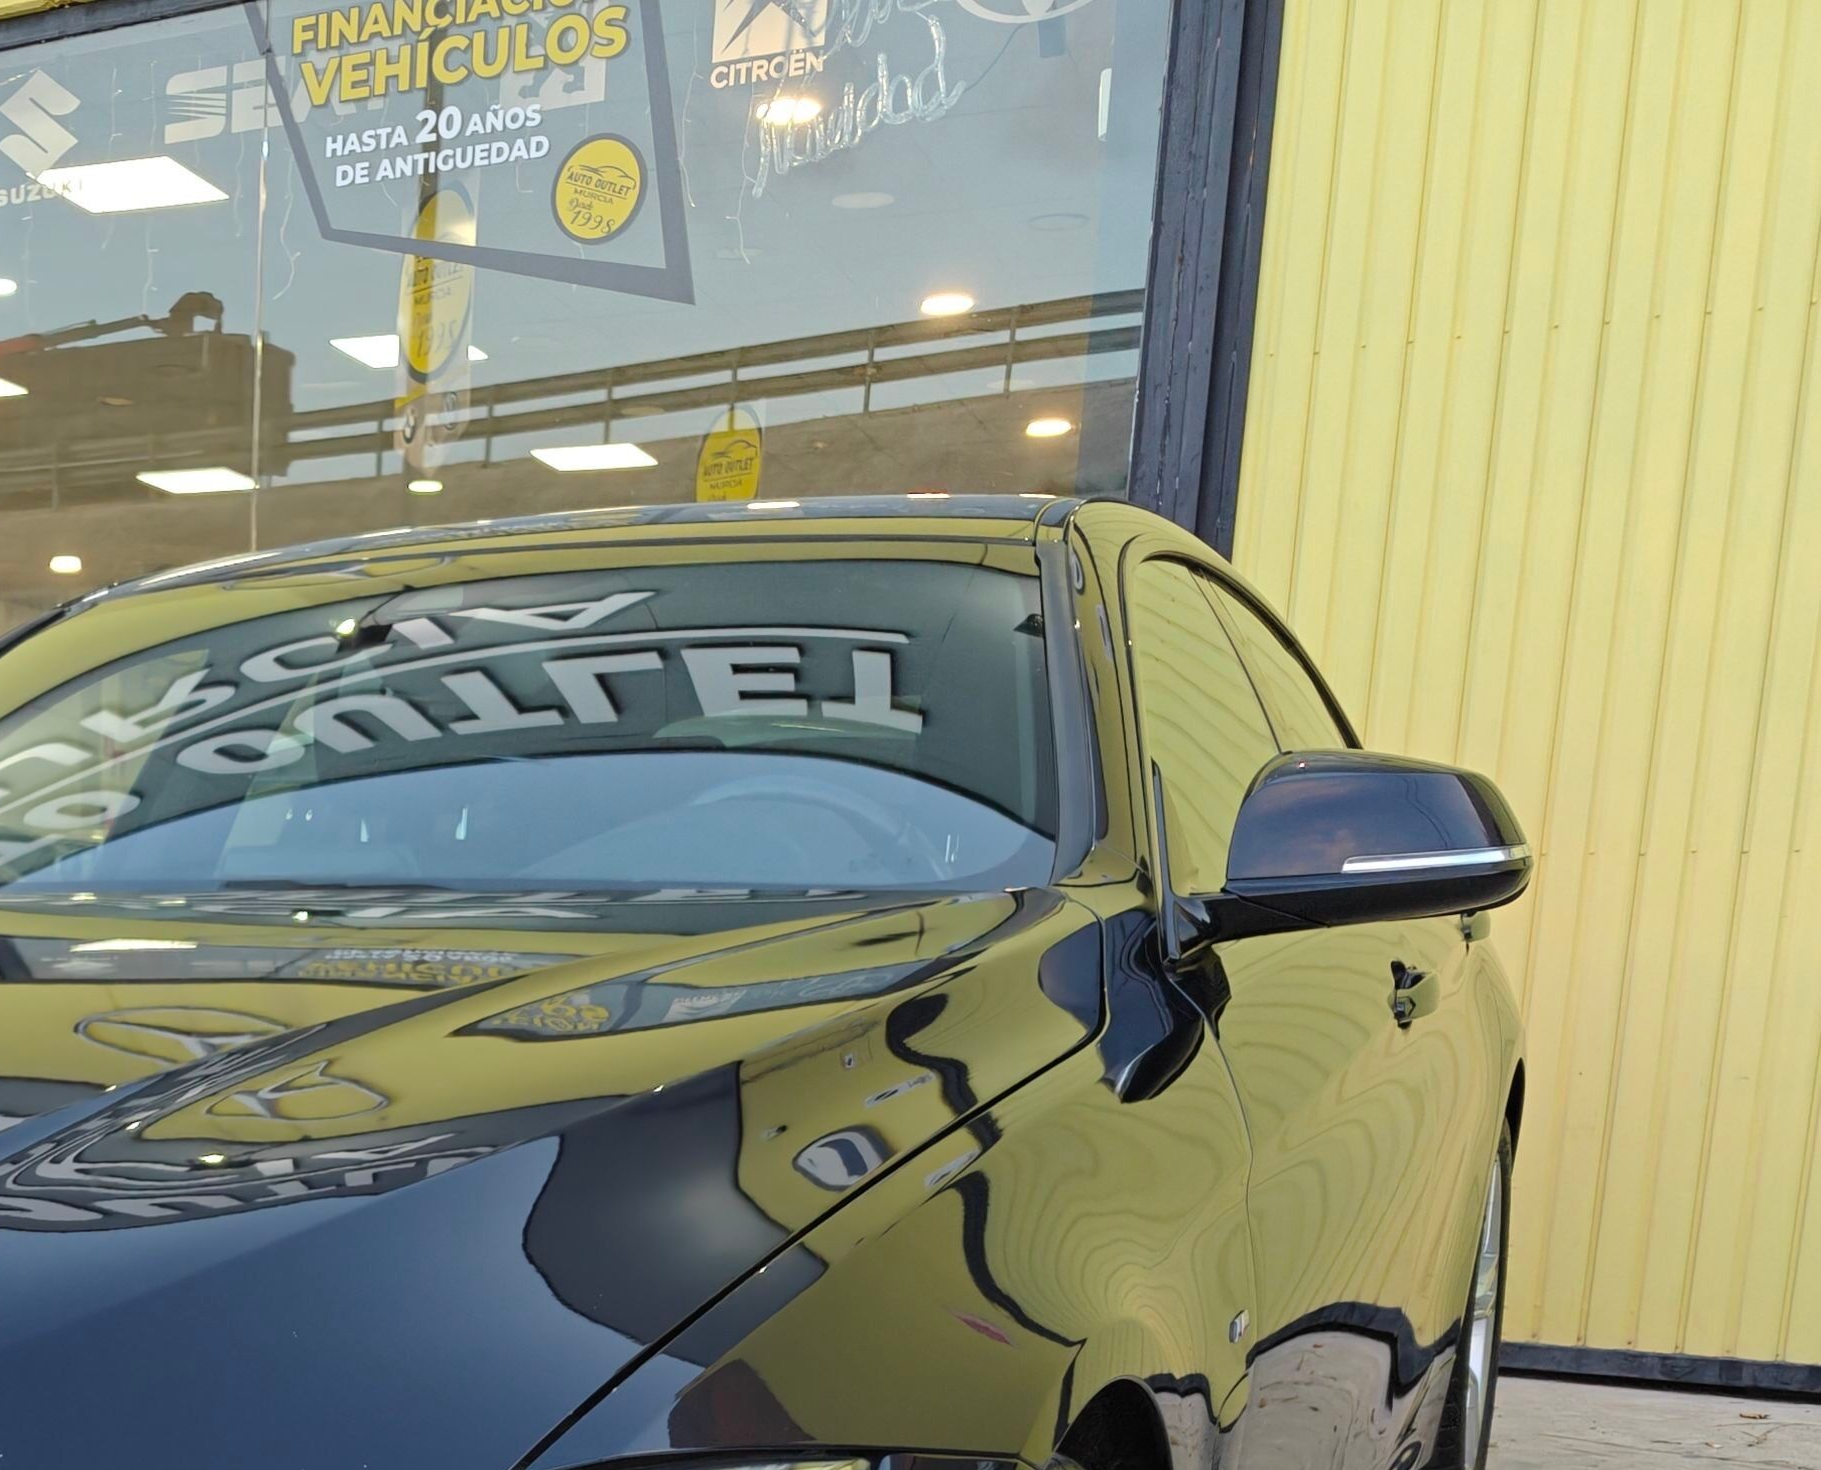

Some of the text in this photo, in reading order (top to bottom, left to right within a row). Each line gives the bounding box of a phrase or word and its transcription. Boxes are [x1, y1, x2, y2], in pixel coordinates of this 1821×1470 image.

[299, 4, 631, 107] VEHÍCULOS
[709, 48, 824, 90] CITROËN
[325, 104, 543, 158] HASTA 20 AÑOS
[335, 135, 551, 188] DE ANTIGUEDAD
[567, 170, 632, 198] AUTO OUTLET
[573, 187, 615, 204] MURCIA
[570, 209, 616, 234] 1998
